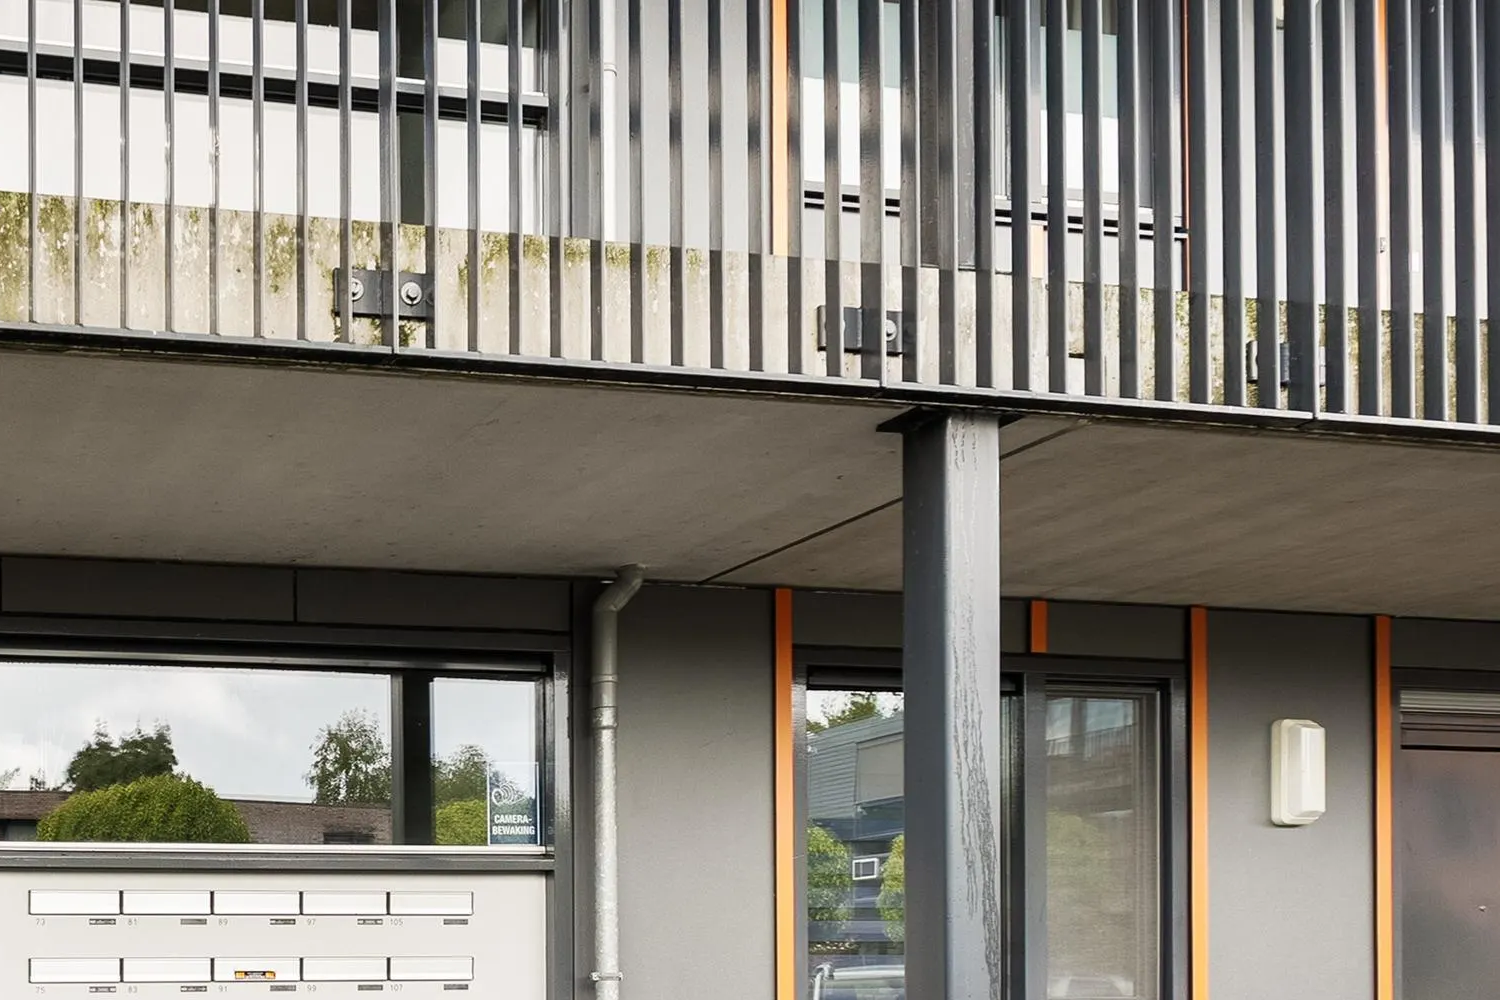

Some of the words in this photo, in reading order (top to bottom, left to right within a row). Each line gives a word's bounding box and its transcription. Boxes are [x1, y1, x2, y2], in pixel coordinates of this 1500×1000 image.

[494, 814, 533, 824] CAMERA-
[492, 825, 535, 836] BEWAKING
[127, 917, 139, 927] 81
[218, 917, 229, 927] 89
[306, 917, 317, 926] 97
[389, 917, 404, 927] 105
[217, 984, 228, 993] 91
[306, 983, 317, 993] 99
[390, 983, 404, 993] 107
